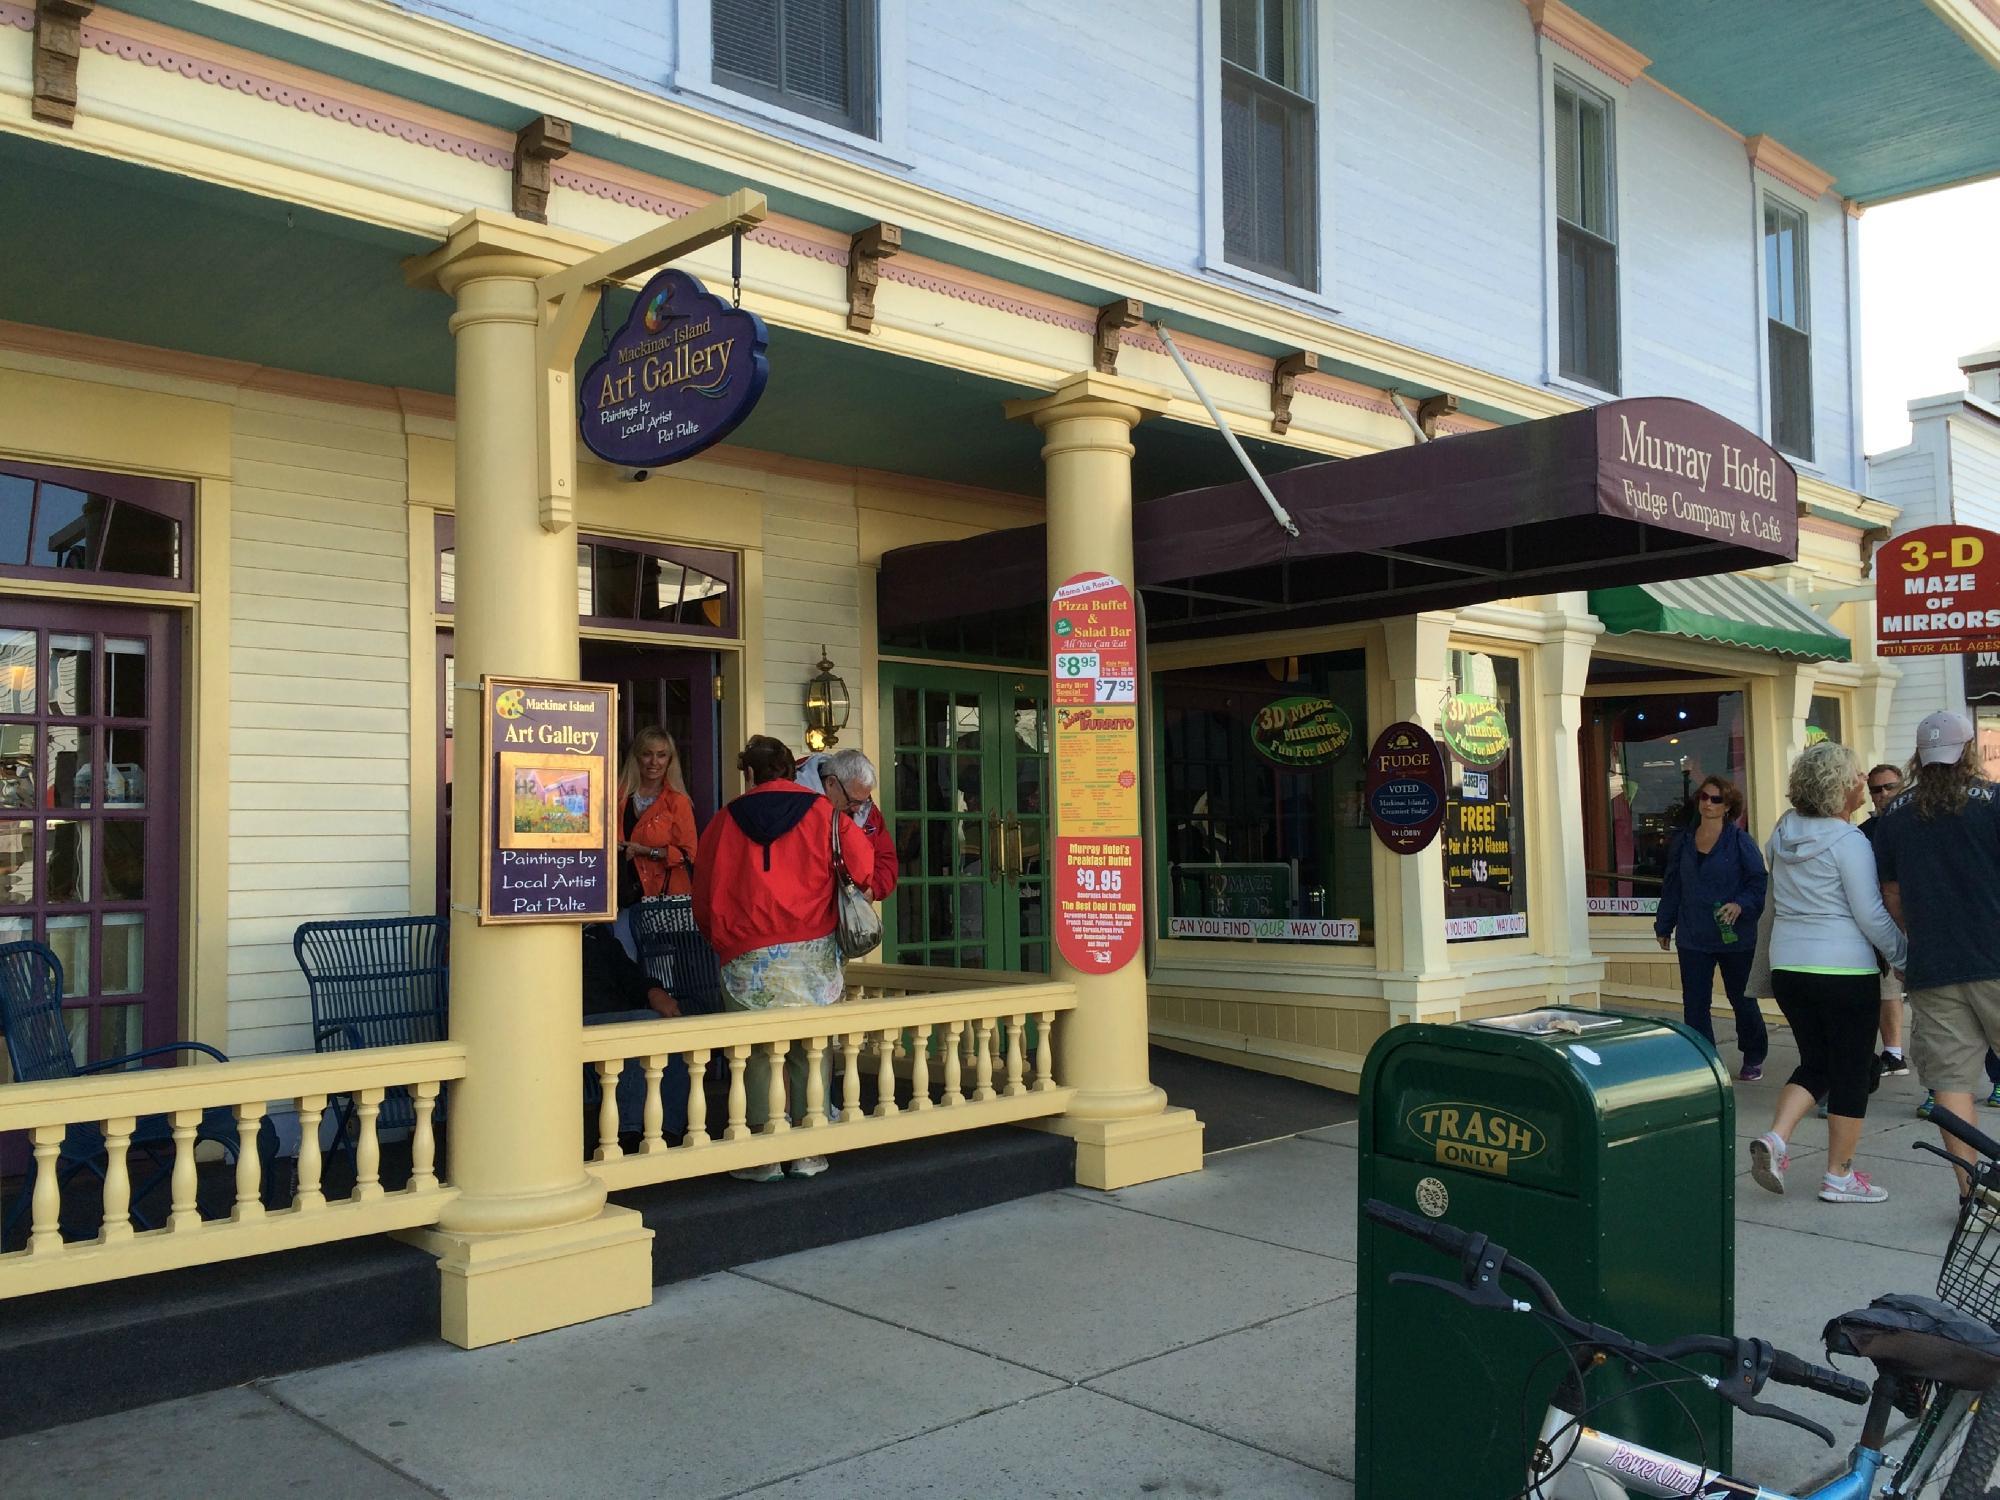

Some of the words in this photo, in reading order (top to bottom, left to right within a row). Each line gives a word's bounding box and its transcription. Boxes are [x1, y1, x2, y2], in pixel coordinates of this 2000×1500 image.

[618, 334, 671, 365] Mackinac
[674, 316, 711, 343] Island
[598, 367, 636, 409] Art
[642, 338, 735, 393] Gallery
[601, 404, 638, 425] Paintings
[639, 398, 651, 415] by
[621, 418, 645, 440] Local
[647, 410, 673, 433] Artist
[658, 430, 673, 445] Pat
[676, 421, 700, 439] Pulte
[1619, 414, 1712, 493] Murray
[1721, 443, 1778, 503] Hotel
[1622, 479, 1668, 521] Fudge
[1672, 491, 1736, 537] Company
[1740, 510, 1751, 534] &
[1752, 512, 1783, 543] Café
[1901, 536, 1985, 573] 3-D
[1904, 573, 1976, 596] MAZE
[1058, 600, 1088, 611] Pizza
[1092, 600, 1127, 611] Buffet
[1926, 597, 1954, 610] OF
[1087, 613, 1098, 624] &
[1882, 609, 2000, 633] MIRRORS
[1074, 627, 1106, 638] Salad
[1110, 627, 1132, 638] Bar
[1063, 639, 1075, 649] All
[1077, 639, 1092, 649] You
[1093, 640, 1110, 650] Can
[1111, 639, 1128, 648] Eat
[1884, 644, 1907, 655] FUN
[1912, 643, 1936, 654] FOR
[1940, 642, 1962, 652] ALL
[1967, 639, 2000, 651] AGES
[526, 698, 567, 712] Mackinac
[569, 700, 595, 713] Island
[1260, 706, 1286, 730] 3D
[1289, 699, 1334, 722] MAZE
[1449, 698, 1466, 721] 3D
[1080, 718, 1135, 731] BURRITO
[1284, 722, 1341, 742] MIRRORS
[1464, 723, 1502, 738] MIRRORS
[504, 723, 534, 743] Art
[538, 724, 599, 754] Gallery
[1270, 740, 1293, 757] Fun
[1296, 746, 1315, 758] For
[1316, 741, 1332, 756] All
[1331, 729, 1350, 749] Ages
[1455, 732, 1471, 752] Fun
[1471, 742, 1486, 755] For
[1379, 753, 1431, 773] FUDGE
[1389, 784, 1419, 794] VOTED
[1460, 805, 1495, 832] FREE!
[1400, 829, 1422, 837] LOBBY
[1069, 843, 1101, 855] Murray
[1103, 844, 1130, 854] Hotel's
[1448, 837, 1461, 855] Pair
[1463, 836, 1469, 854] of
[1471, 837, 1484, 854] 3-D
[1485, 836, 1508, 854] Glasses
[501, 851, 575, 869] Paintings
[578, 851, 597, 868] by
[1067, 855, 1106, 866] Breakfast
[1108, 855, 1132, 866] Buffet
[502, 874, 547, 890] Local
[551, 873, 598, 891] Artist
[1077, 867, 1121, 892] $9.95
[512, 897, 542, 913] Pat
[546, 897, 587, 913] Pulte
[1062, 901, 1074, 910] The
[1075, 901, 1091, 911] Best
[1093, 901, 1108, 912] Deal
[1118, 902, 1136, 912] Town
[1588, 899, 1606, 911] OU
[1610, 900, 1639, 911] FIND
[1171, 919, 1195, 933] CAN
[1198, 919, 1219, 934] YOU
[1223, 920, 1250, 935] FIND
[1253, 920, 1285, 937] YOUR
[1290, 922, 1317, 937] WAY
[1321, 923, 1355, 939] OUT?
[1450, 920, 1462, 936] YOU
[1463, 920, 1478, 935] FIND
[1496, 918, 1509, 932] WAY
[1420, 1109, 1532, 1153] TRASH
[1444, 1146, 1499, 1169] ONLY
